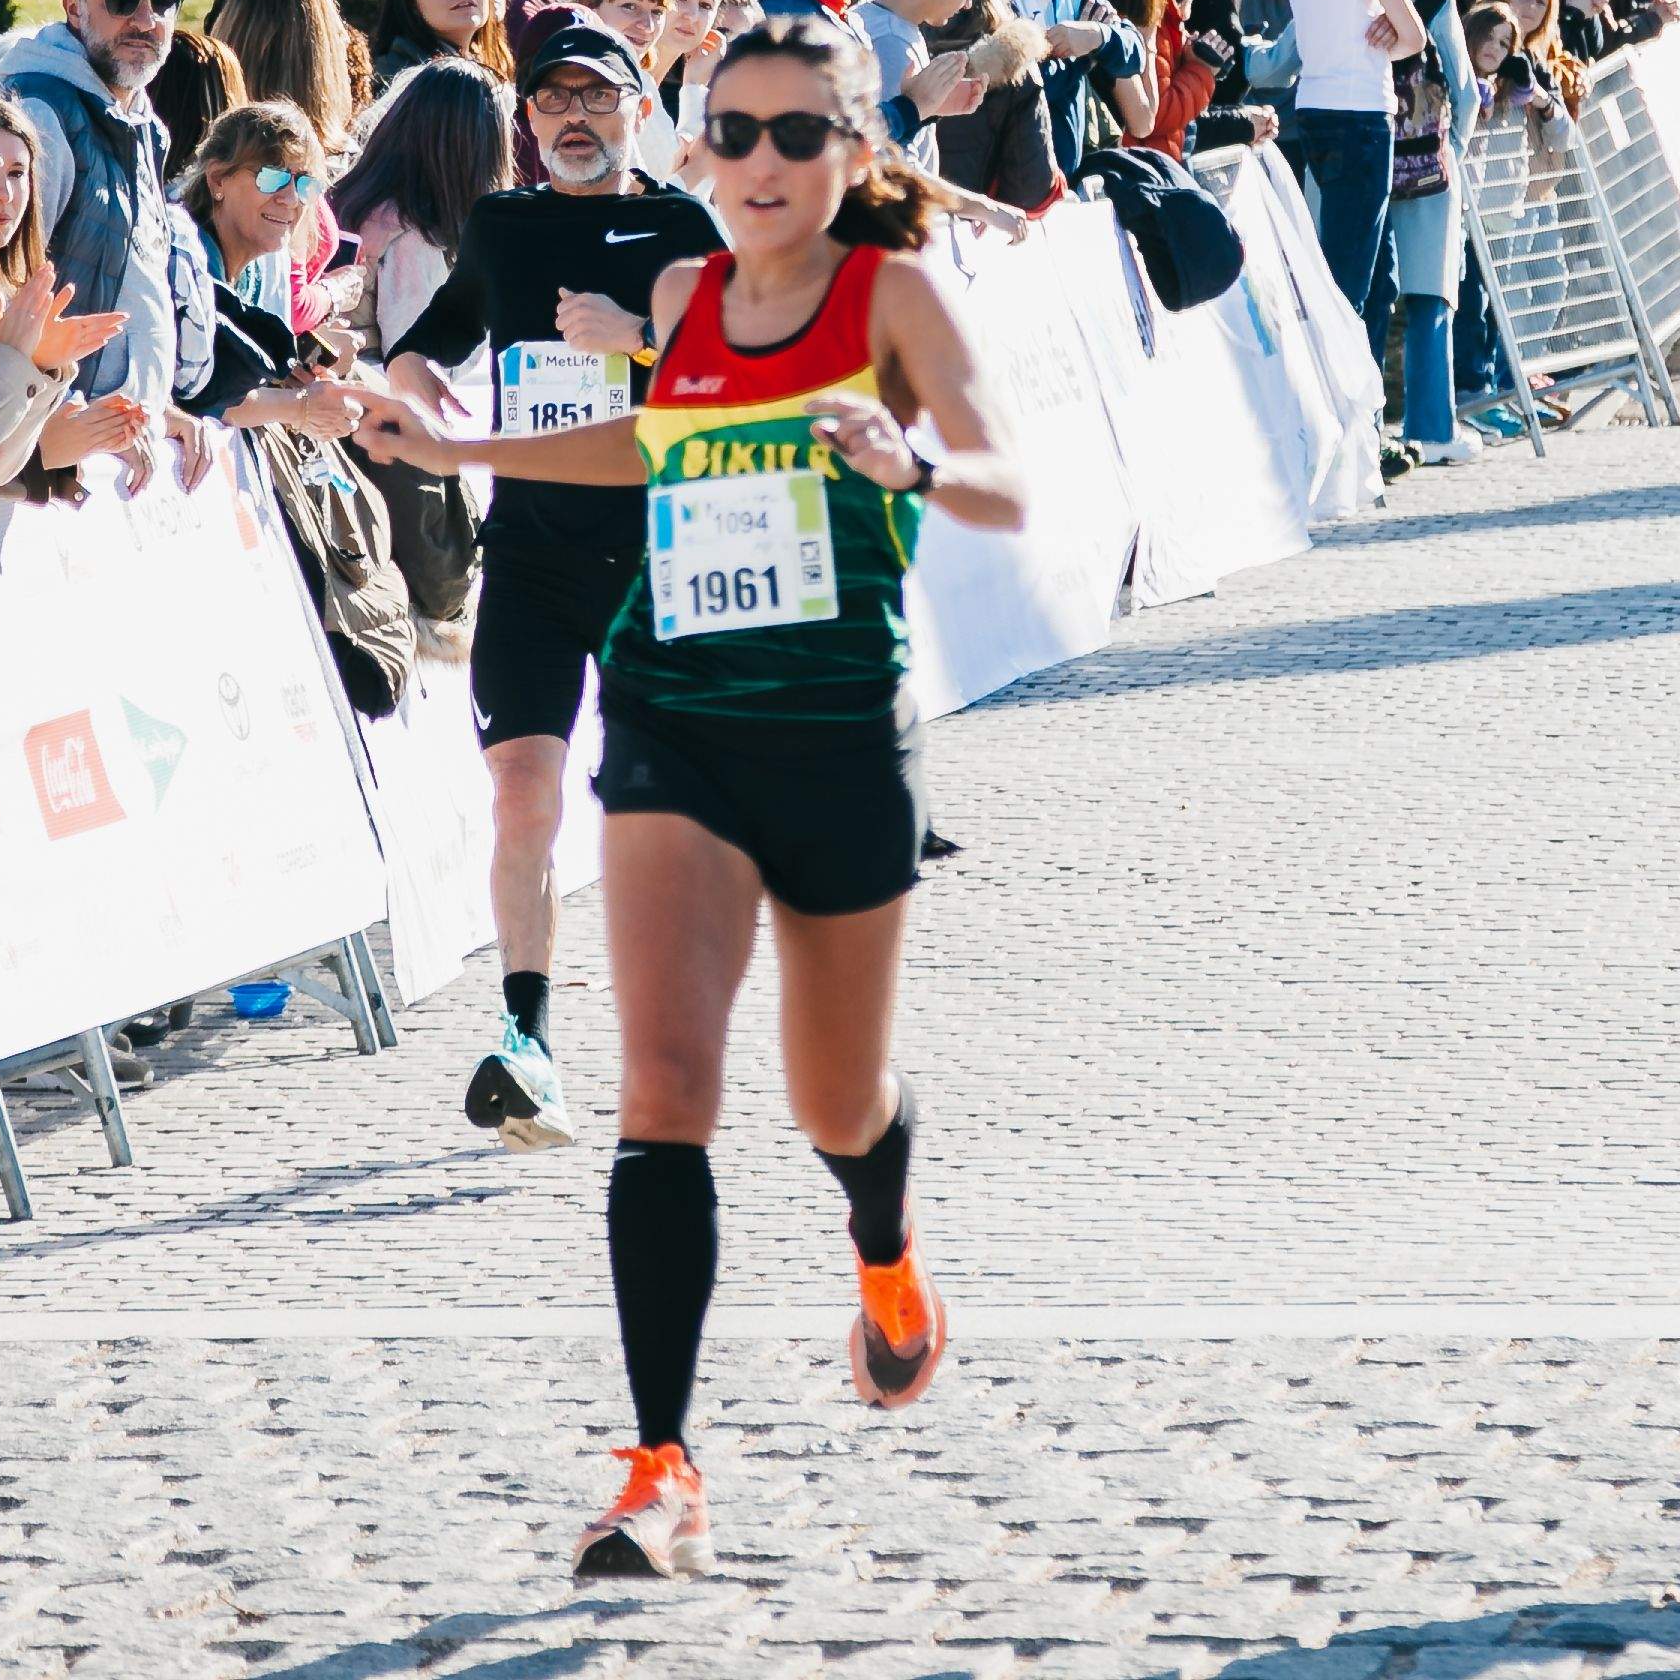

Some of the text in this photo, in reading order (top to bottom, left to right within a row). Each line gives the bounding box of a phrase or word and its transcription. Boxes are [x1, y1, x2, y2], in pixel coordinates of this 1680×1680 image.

[545, 354, 599, 367] MetLife
[528, 402, 593, 434] 1851
[714, 511, 769, 534] 1094
[687, 564, 781, 618] 1961
